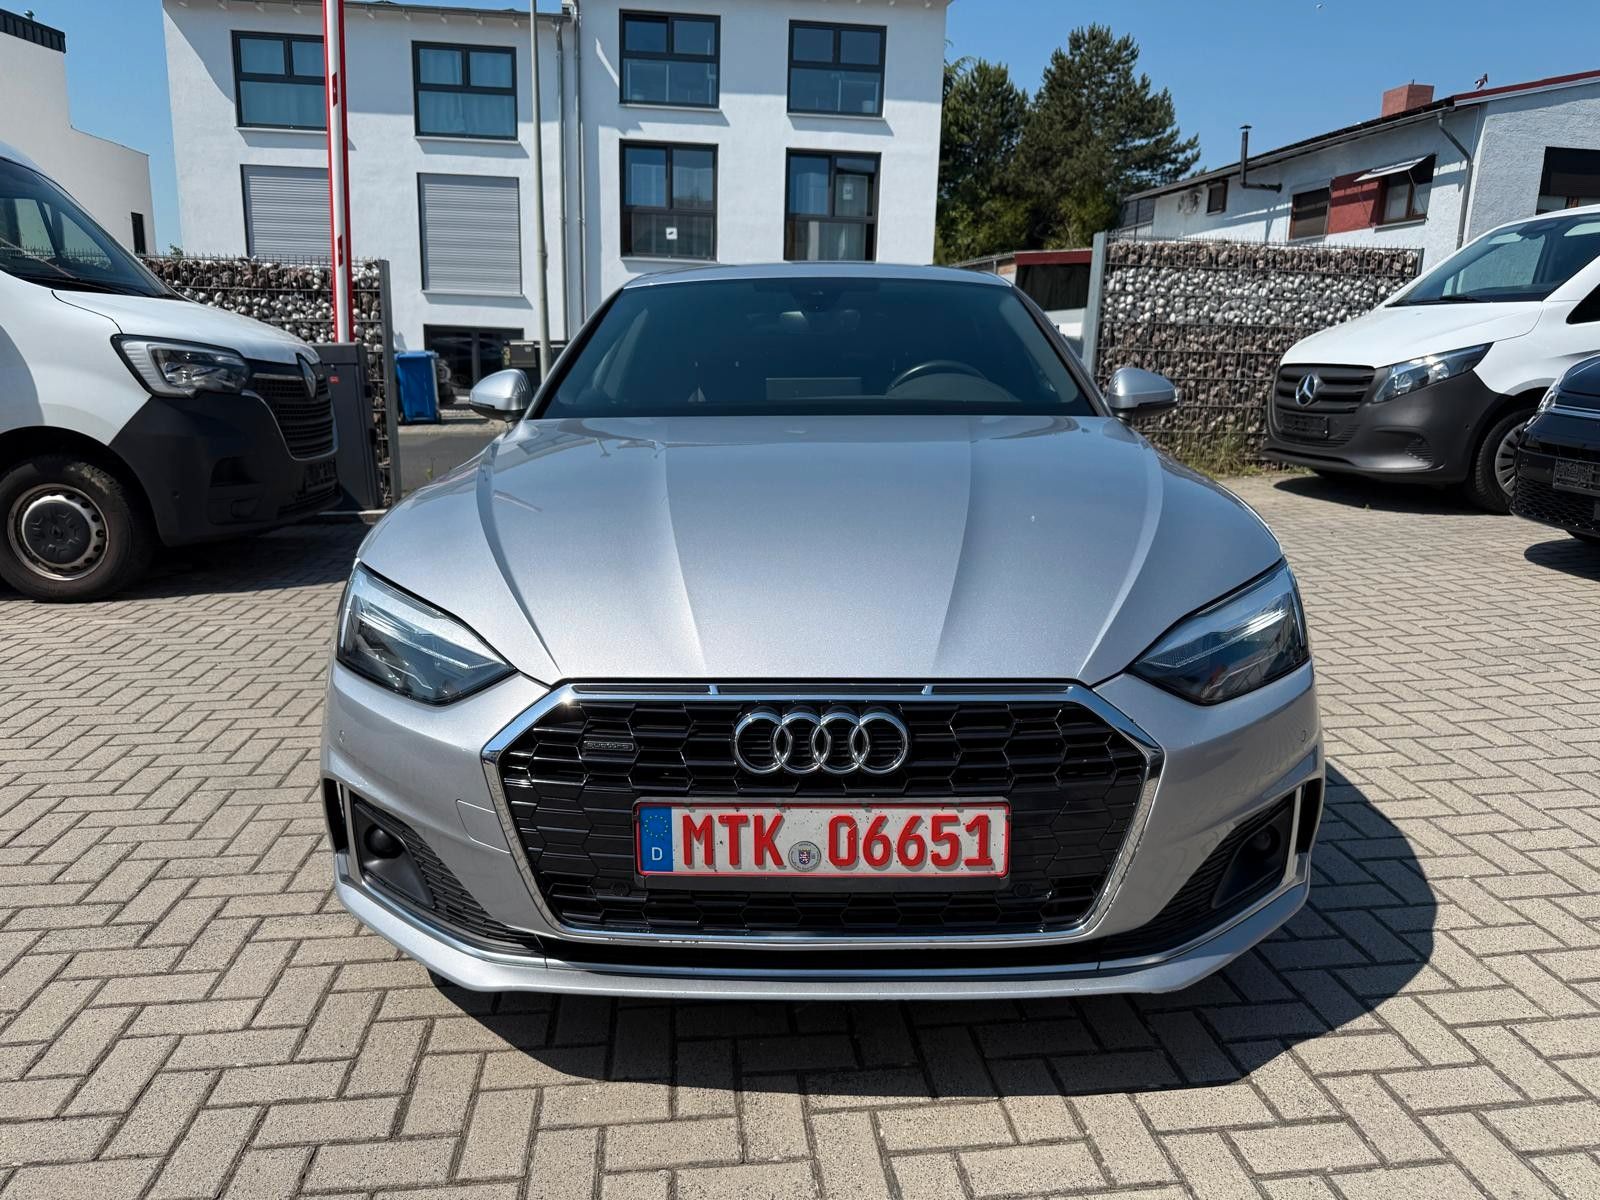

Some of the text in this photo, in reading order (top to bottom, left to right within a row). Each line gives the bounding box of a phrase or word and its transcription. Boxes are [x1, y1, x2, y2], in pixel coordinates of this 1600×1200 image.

[651, 847, 663, 861] D
[682, 814, 785, 866] MTK
[828, 814, 993, 867] 06651
